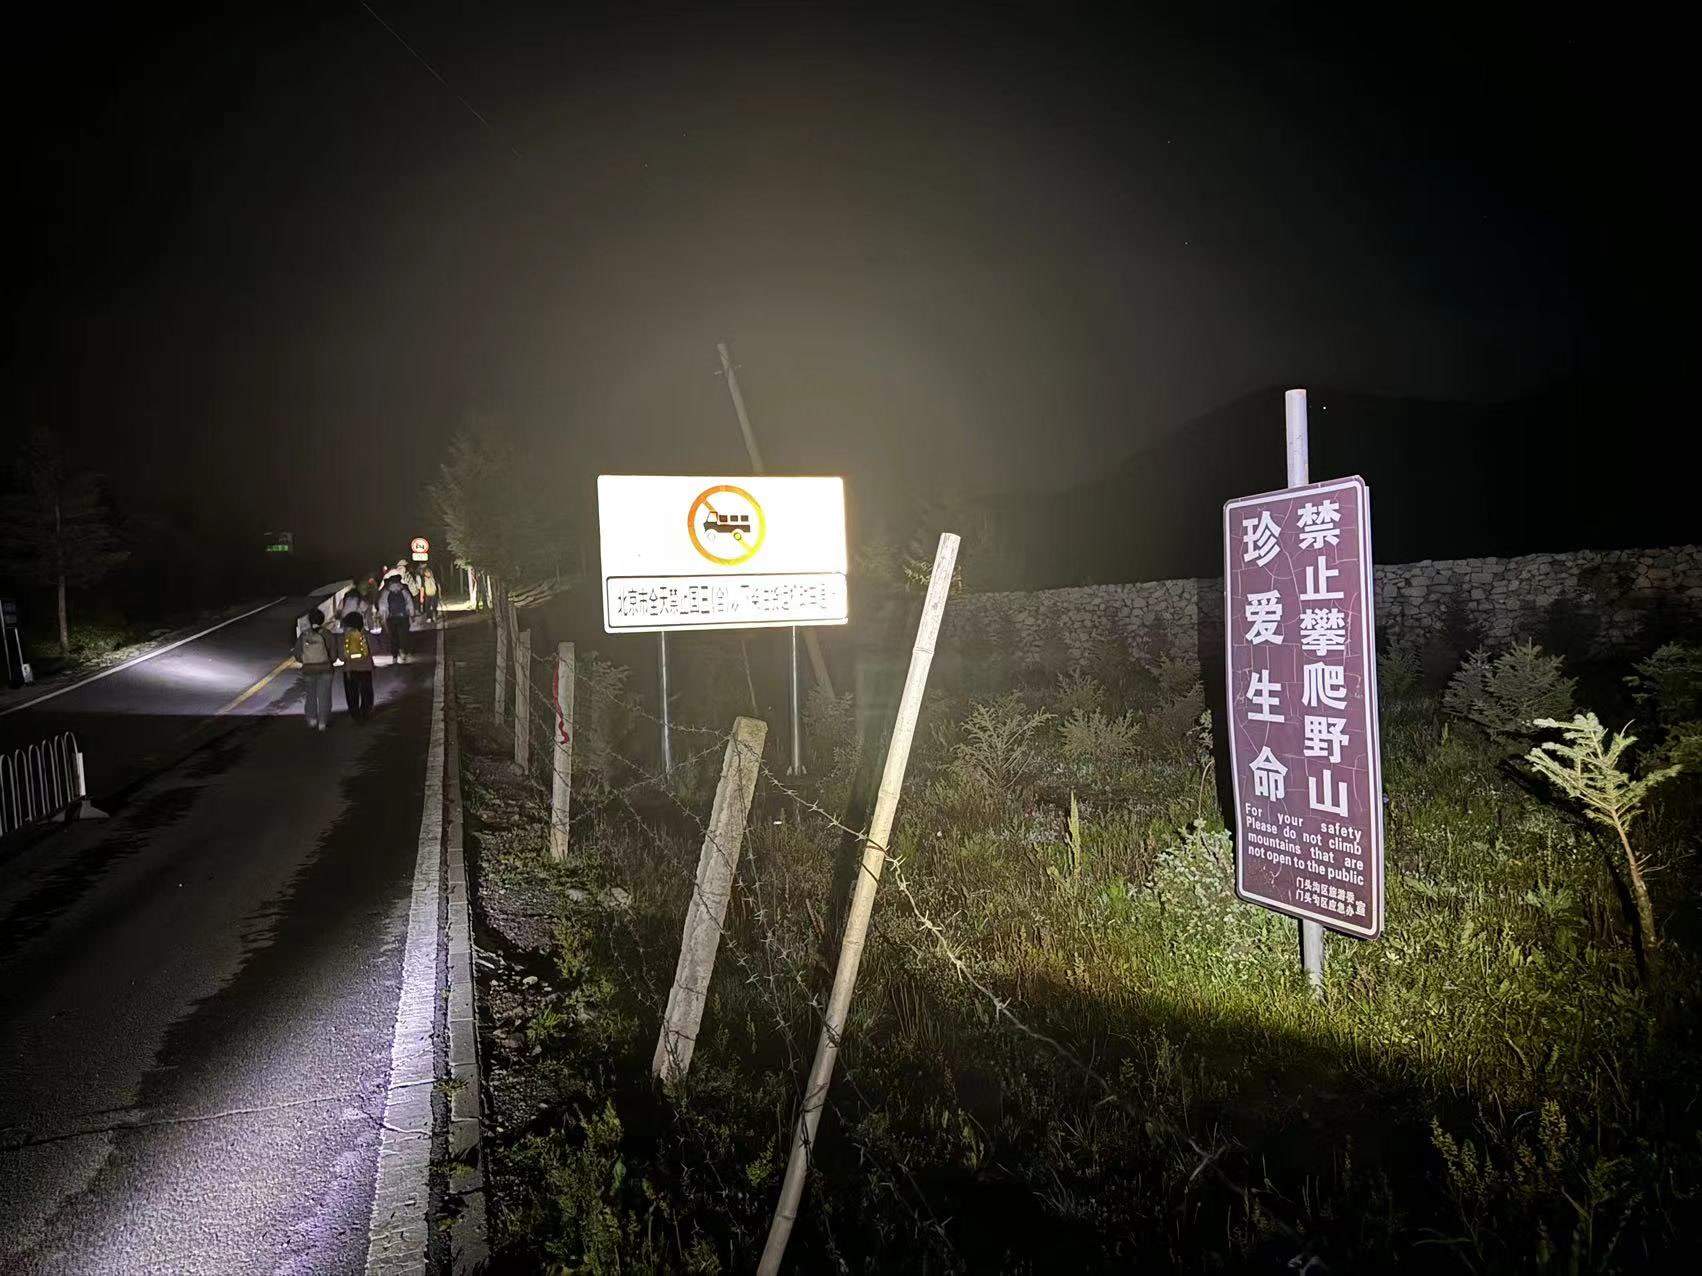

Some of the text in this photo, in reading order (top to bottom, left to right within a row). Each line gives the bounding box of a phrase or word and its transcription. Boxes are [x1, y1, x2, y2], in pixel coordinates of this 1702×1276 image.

[1242, 510, 1288, 802] 珍爱生命
[1297, 499, 1349, 818] 禁止攀爬野山
[1245, 803, 1361, 842] For your safety
[1246, 817, 1362, 855] Please do not climb
[1248, 832, 1363, 870] mountains that are
[1248, 845, 1364, 885] not open to the public
